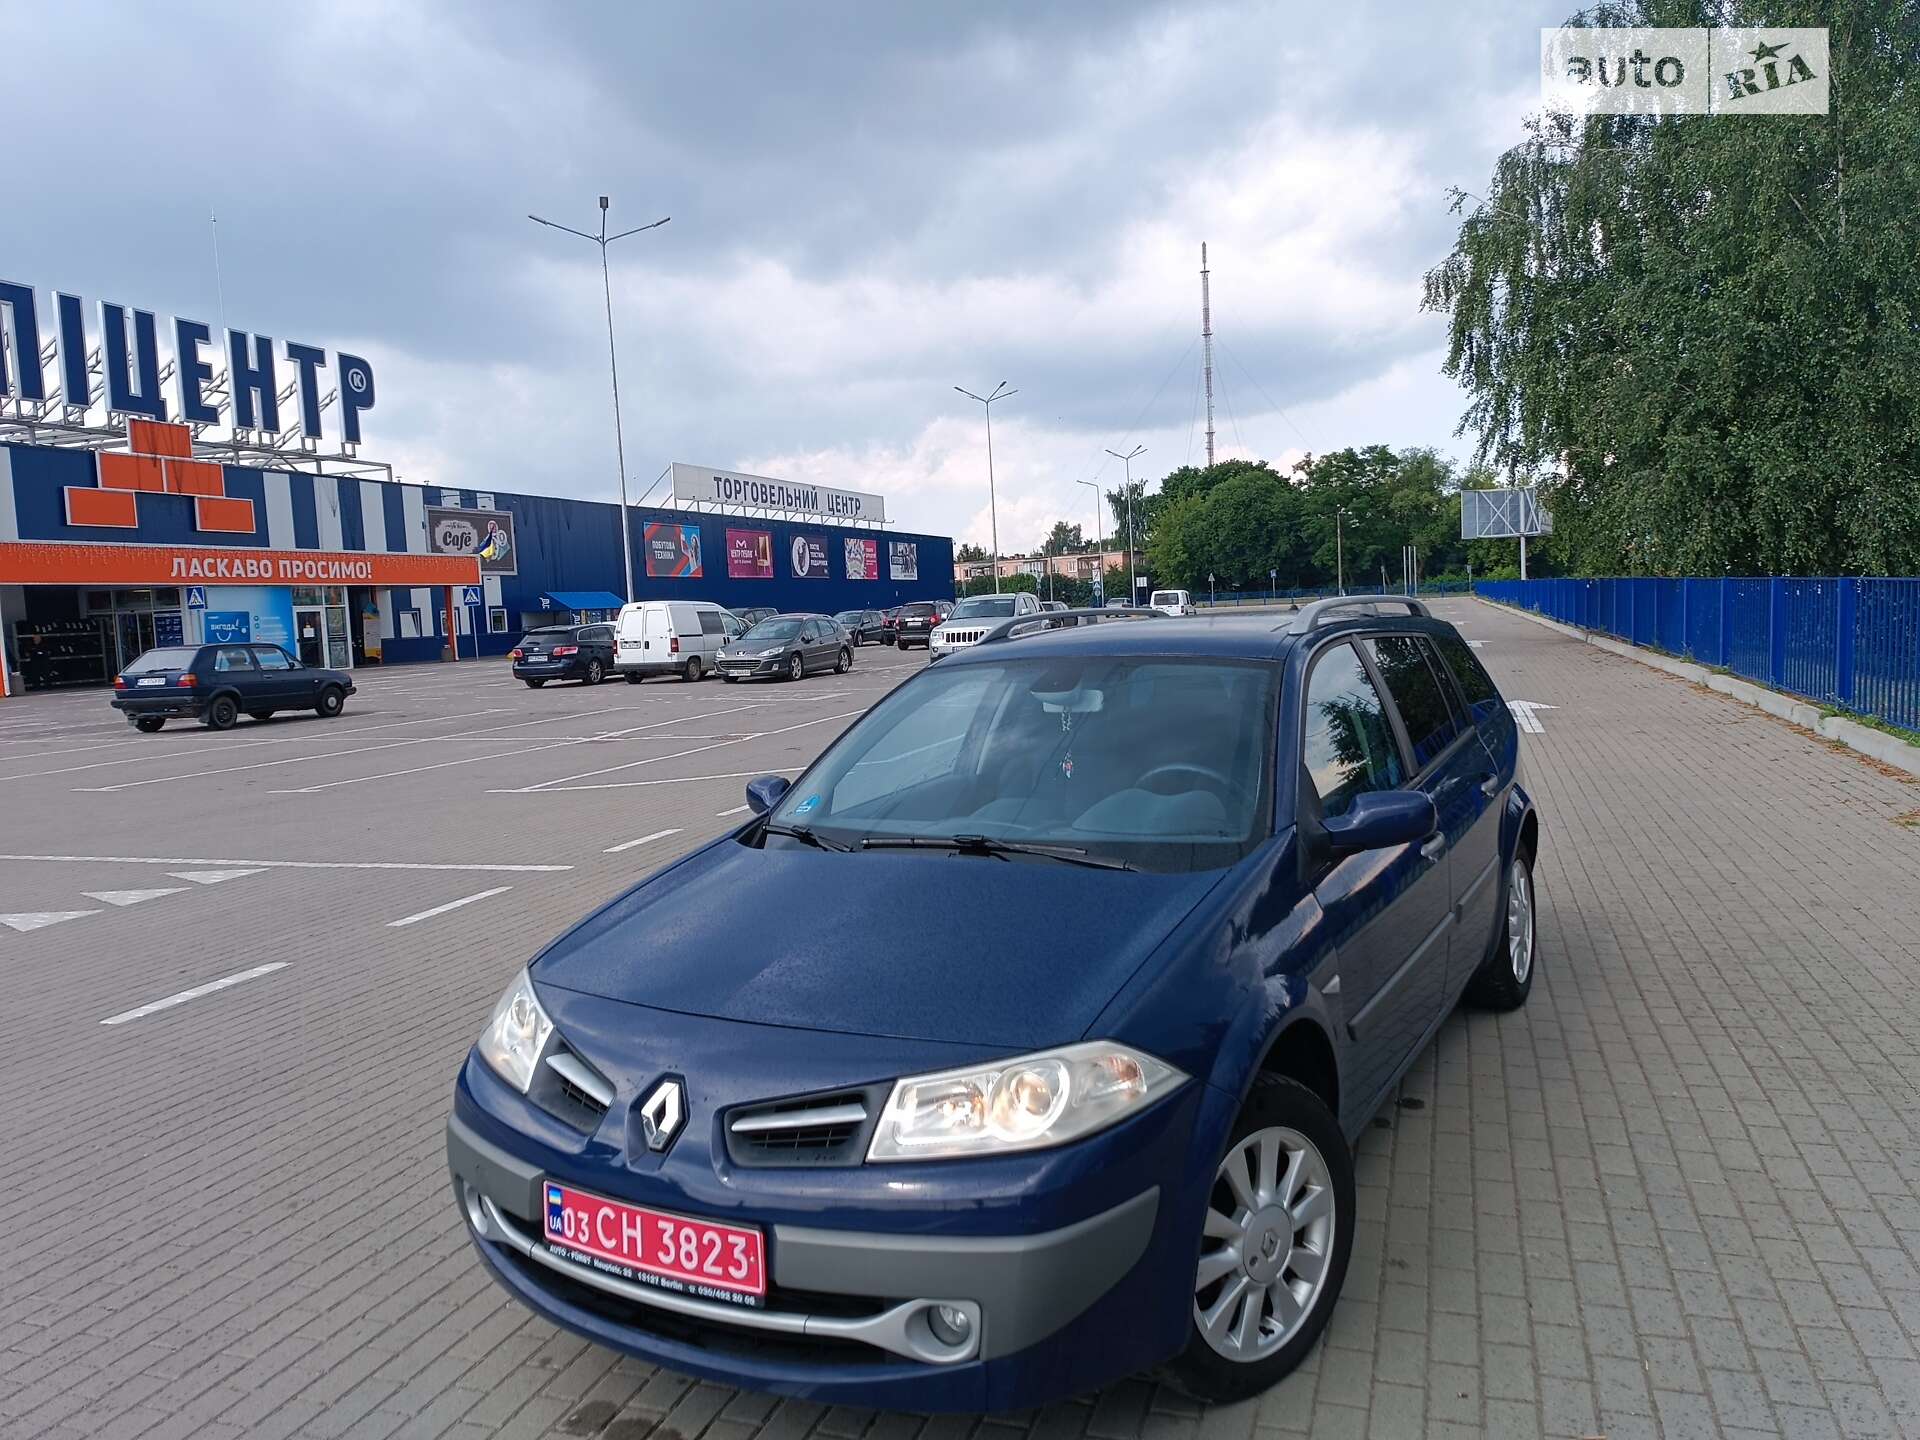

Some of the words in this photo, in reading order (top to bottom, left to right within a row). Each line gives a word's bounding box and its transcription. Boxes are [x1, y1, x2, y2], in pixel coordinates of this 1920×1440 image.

[713, 476, 819, 510] ТОРГОВЕЛЬНИЙ
[827, 493, 861, 516] ЦЕНТР
[442, 531, 472, 551] Café
[171, 557, 273, 578] ЛАСКАВО
[279, 560, 373, 579] ПРОСИМО!
[549, 1215, 562, 1232] UA
[563, 1207, 590, 1243] 03
[596, 1206, 642, 1258] CH
[657, 1220, 748, 1280] 3823
[660, 1278, 683, 1291] Berlin
